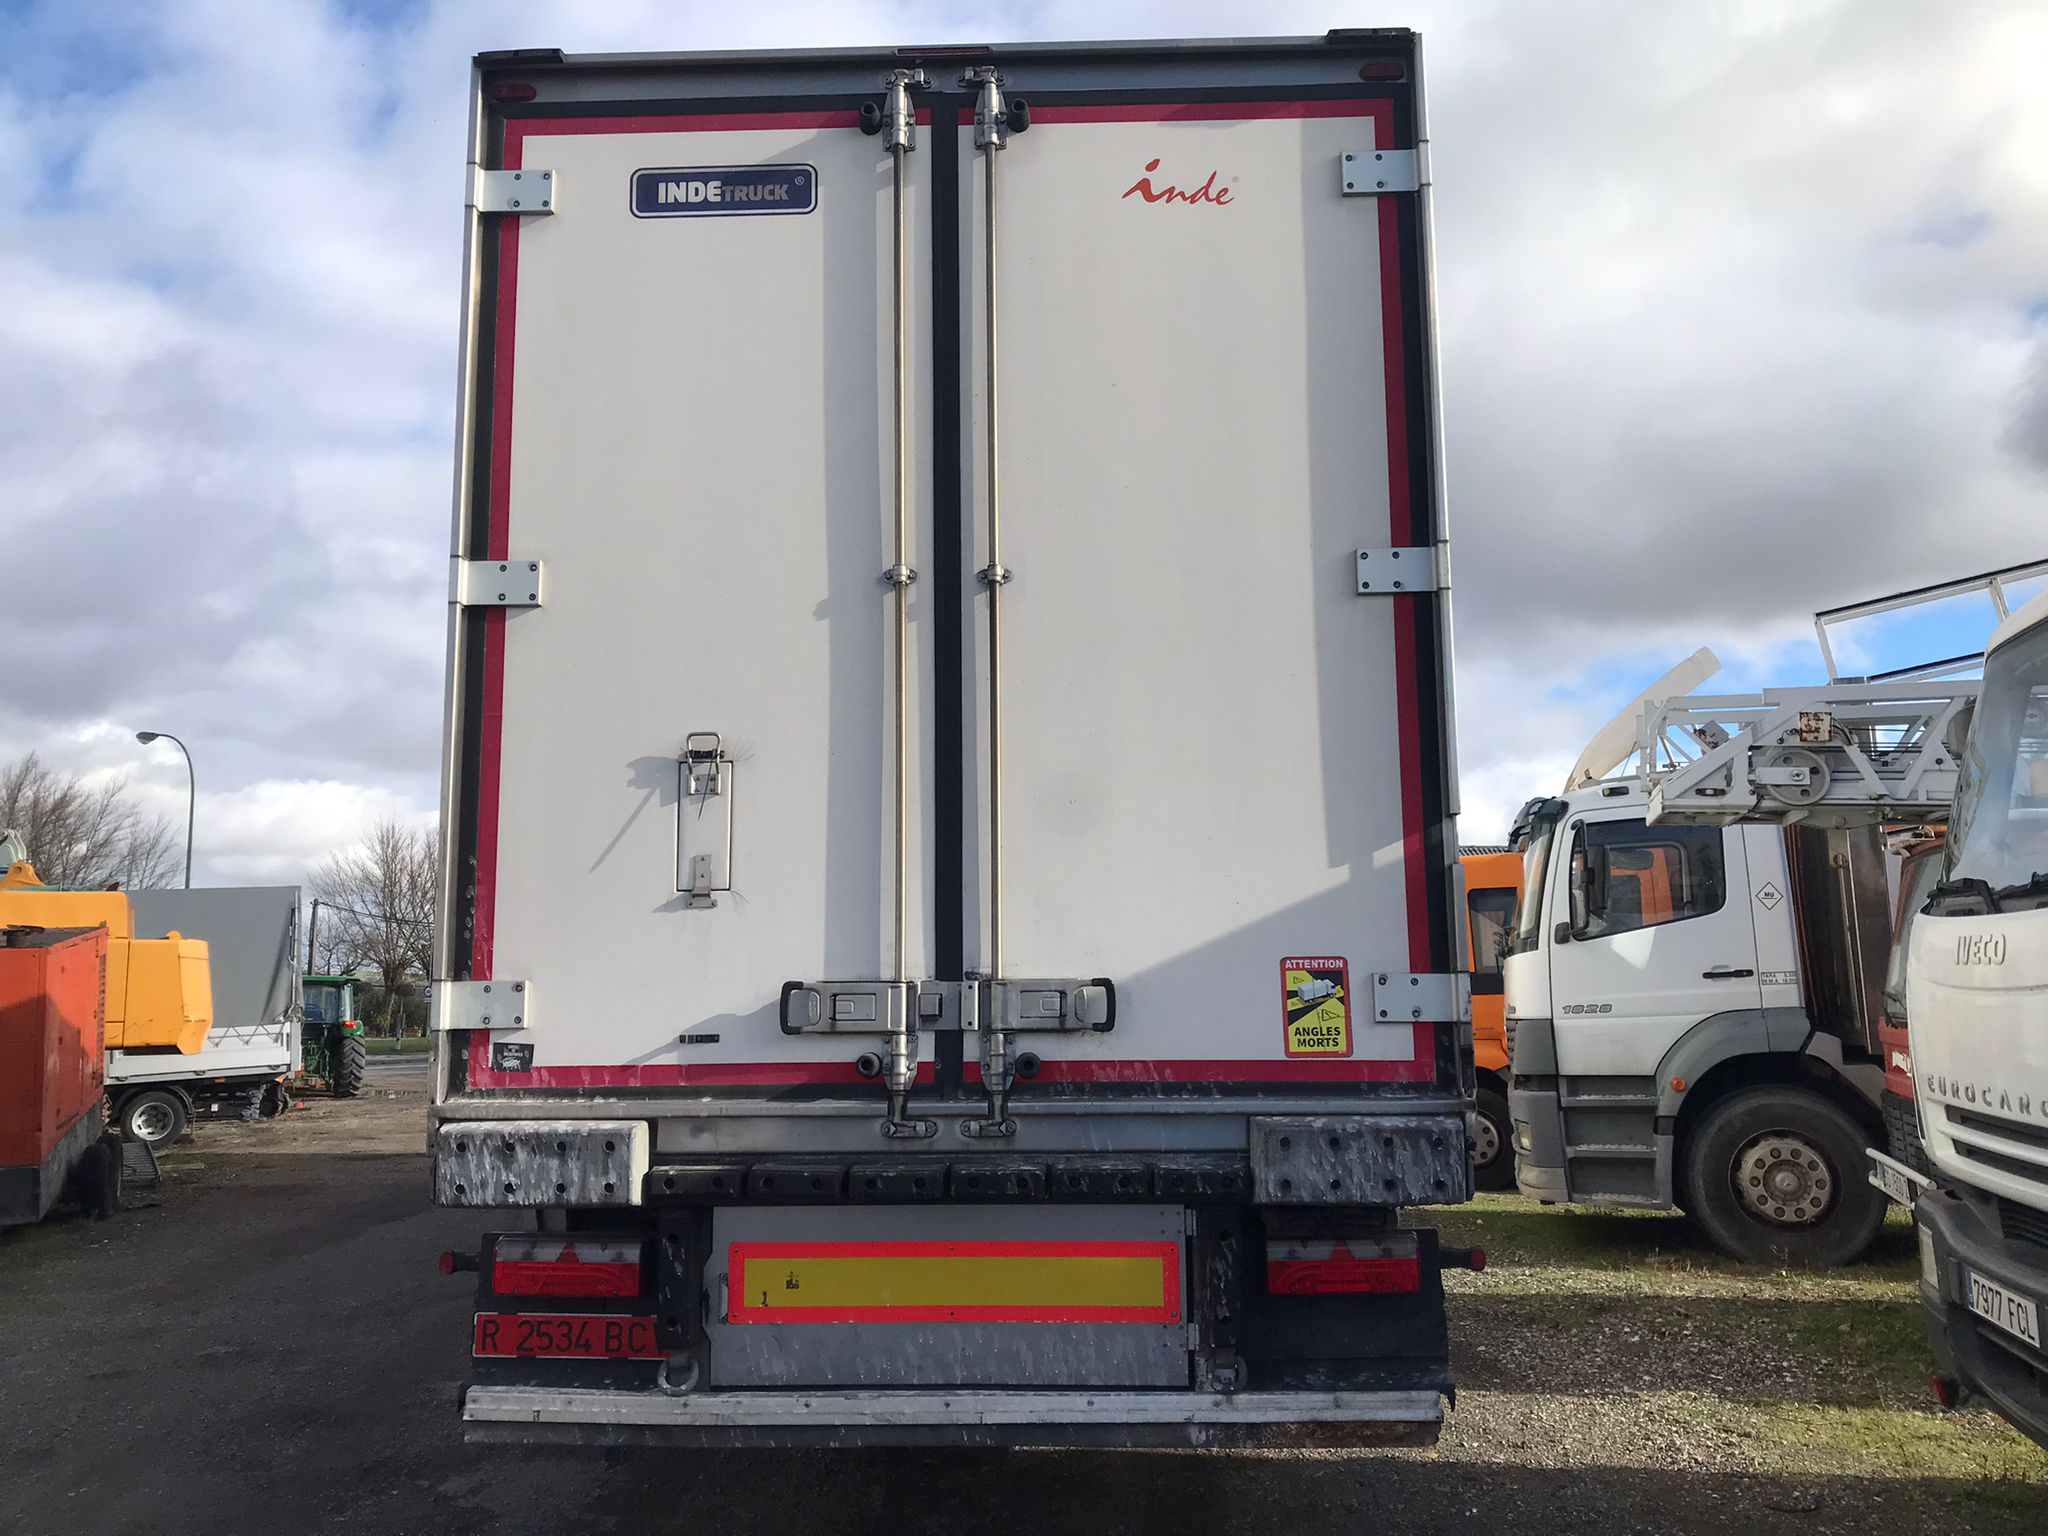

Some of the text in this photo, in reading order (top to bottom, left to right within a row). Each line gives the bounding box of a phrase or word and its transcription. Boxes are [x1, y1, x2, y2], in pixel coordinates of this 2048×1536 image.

[1121, 158, 1235, 206] inde
[1285, 959, 1344, 969] ATTENTION
[1955, 933, 2006, 966] IVECO
[1294, 1026, 1341, 1037] ANGLES
[1297, 1037, 1339, 1048] MORTS
[1973, 1278, 2036, 1342] 7977 FCL
[481, 1318, 662, 1355] R 2534 BC
